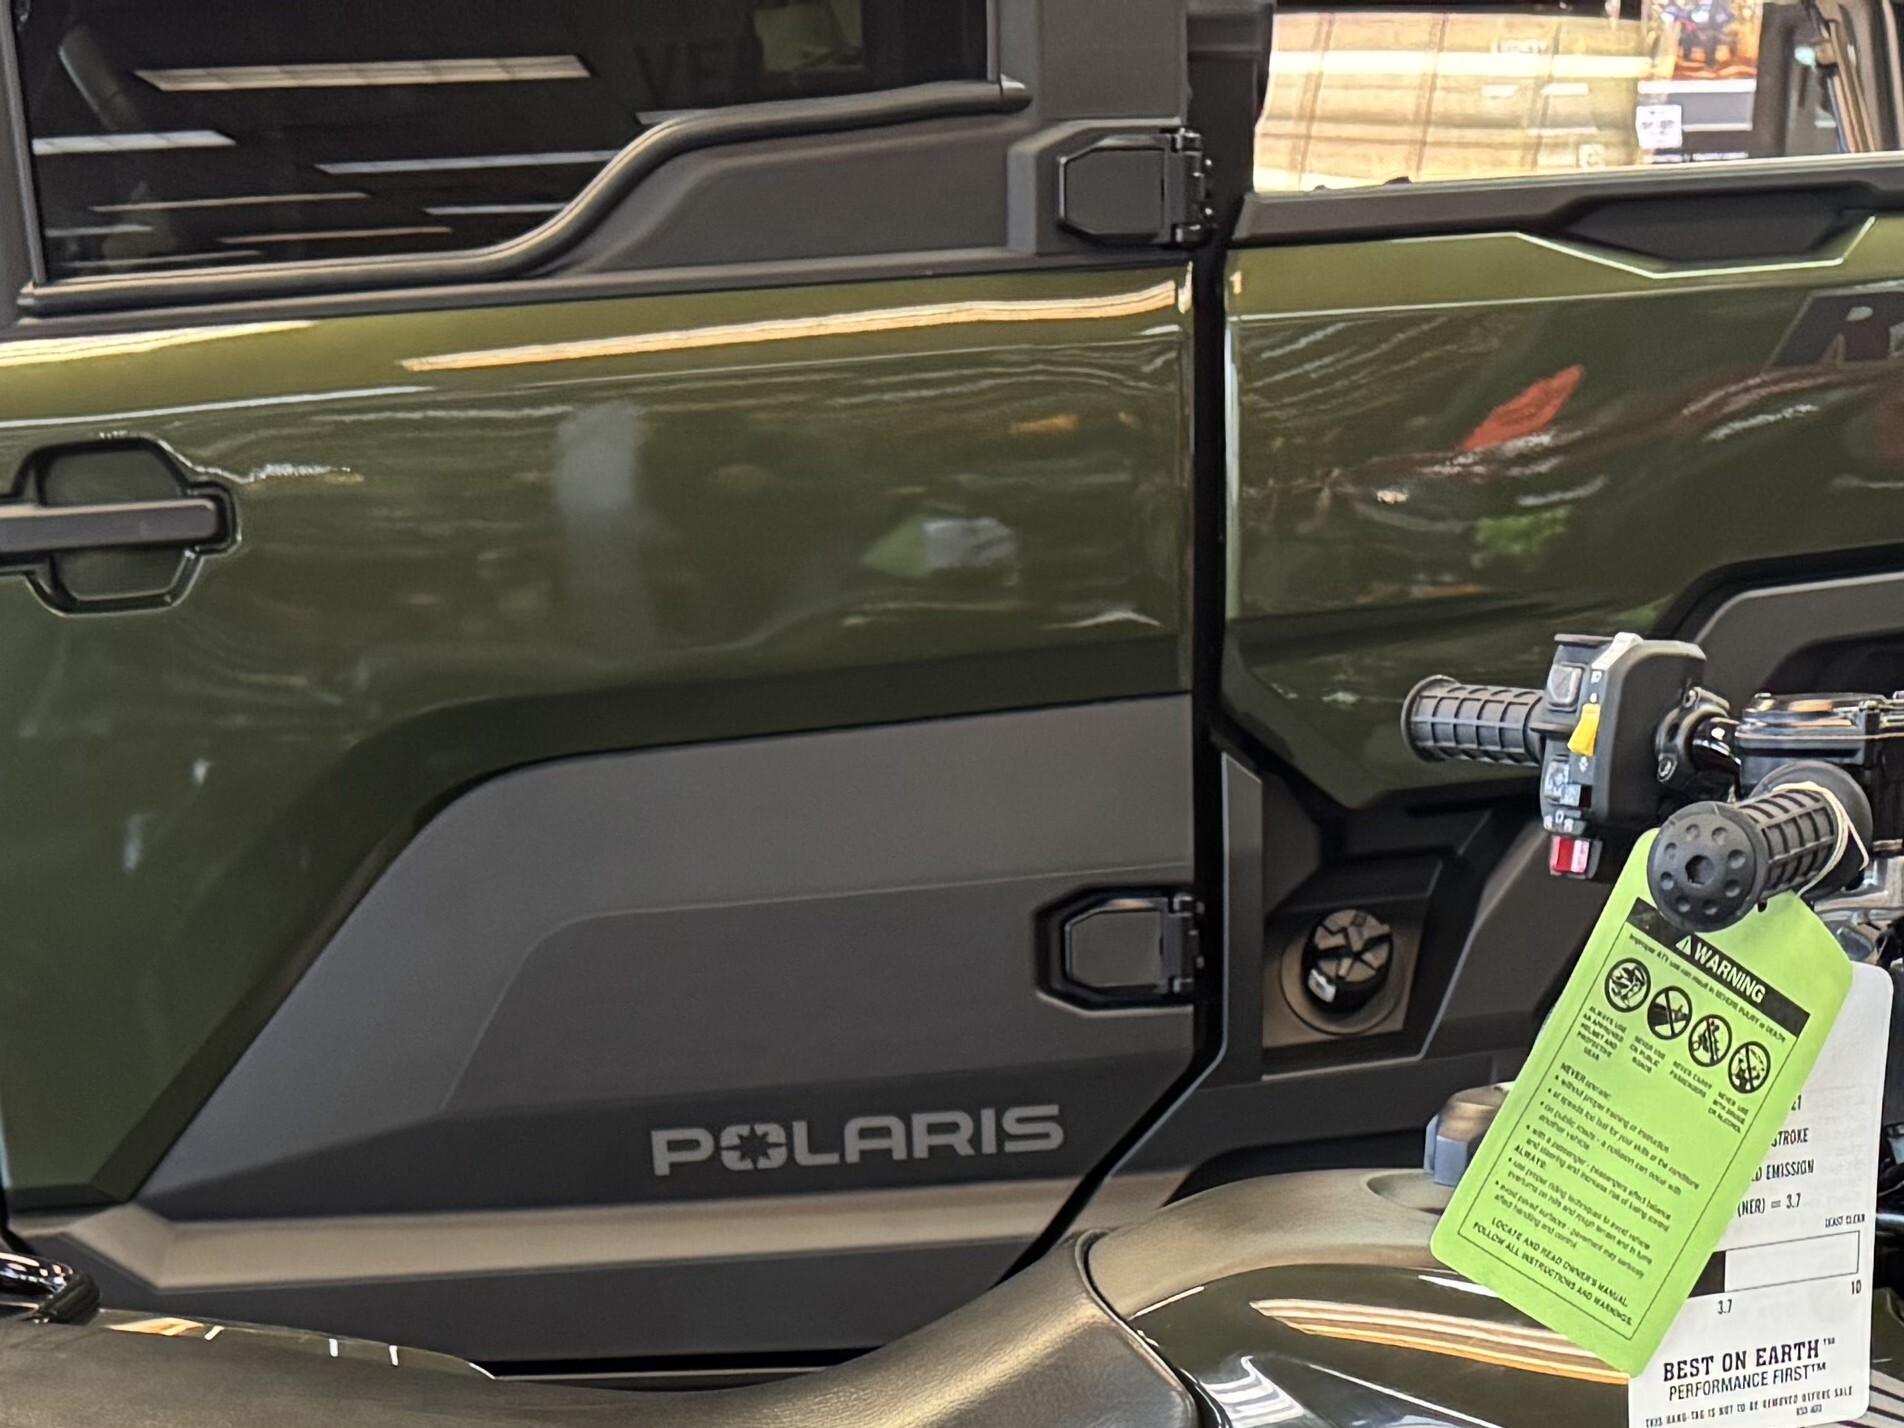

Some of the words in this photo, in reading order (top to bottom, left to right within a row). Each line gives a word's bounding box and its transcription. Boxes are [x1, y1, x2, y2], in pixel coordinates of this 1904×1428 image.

[1695, 942, 1766, 1003] WARNING
[650, 1103, 1066, 1177] POLARIS
[1766, 1159, 1815, 1181] EMISSION
[1737, 1198, 1766, 1218] (NER)
[1786, 1192, 1802, 1210] 3.7
[1851, 1280, 1862, 1296] 10
[1717, 1299, 1733, 1316] 3.7
[1663, 1355, 1715, 1382] BEST
[1722, 1350, 1748, 1373] ON
[1668, 1371, 1769, 1401] PERFORMANCE
